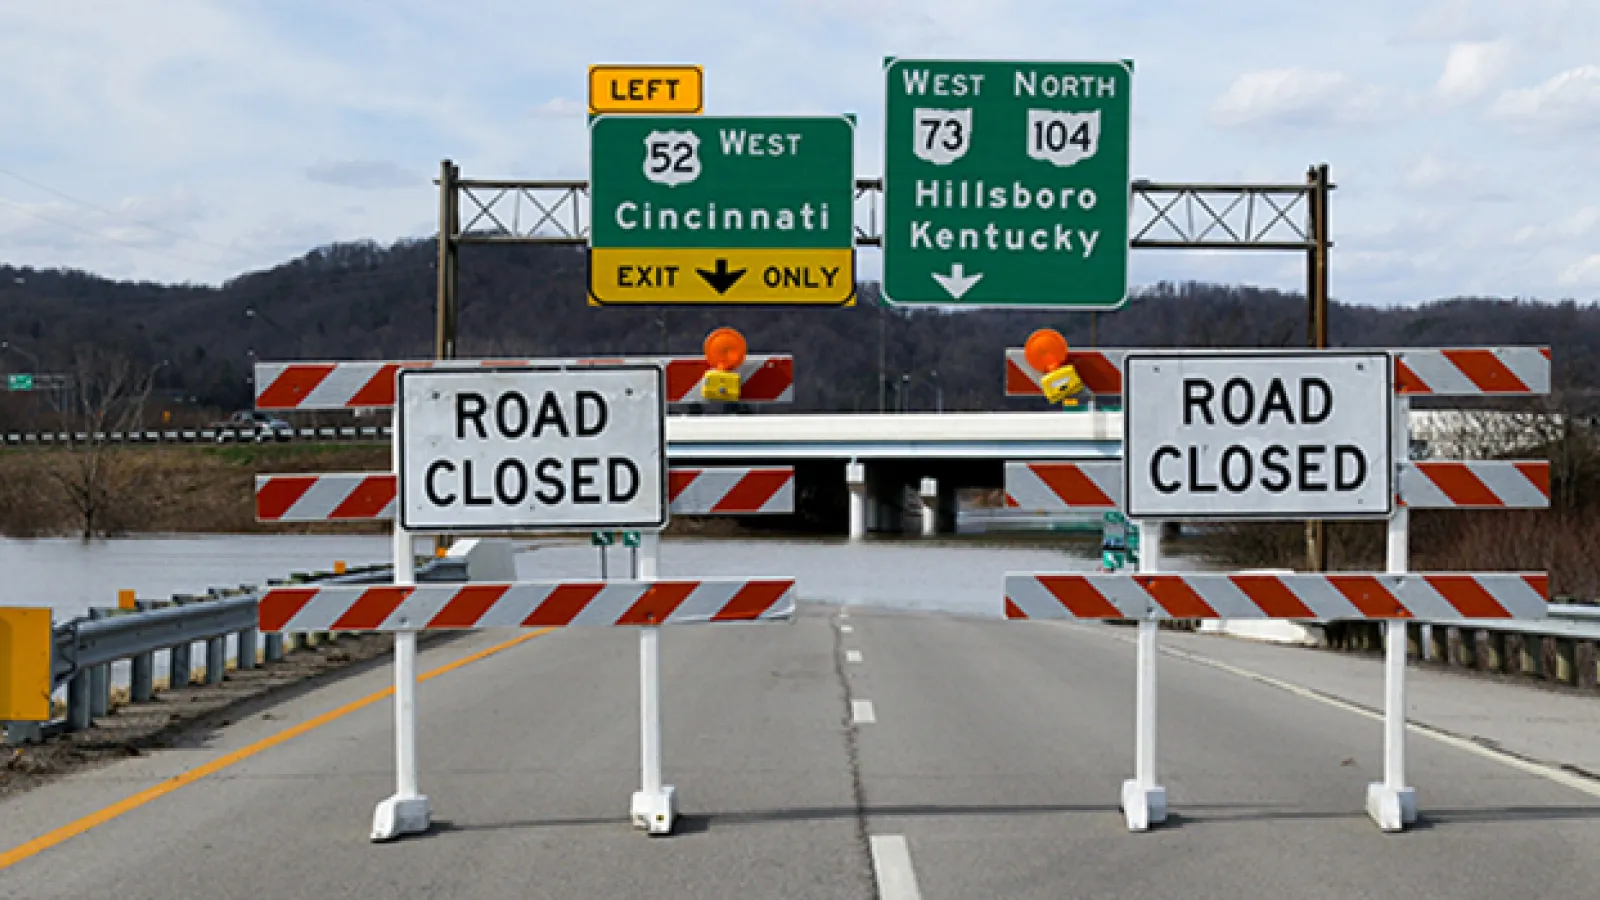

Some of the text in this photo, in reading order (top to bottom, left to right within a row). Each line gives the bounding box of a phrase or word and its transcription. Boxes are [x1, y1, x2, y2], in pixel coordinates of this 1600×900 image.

[611, 79, 680, 100] LEFT
[903, 69, 985, 95] WEST
[1015, 71, 1115, 97] NORTH
[720, 129, 801, 155] WEST
[920, 120, 963, 150] 73
[1034, 121, 1090, 152] 104
[651, 142, 693, 173] 52
[916, 180, 1097, 209] Hillsboro
[615, 202, 829, 230] Cincinnati
[911, 221, 1099, 259] Kentucky
[617, 266, 839, 287] EXIT ONLY
[455, 391, 608, 438] ROAD
[1183, 377, 1332, 425] ROAD
[425, 458, 641, 507] CLOSED
[1150, 445, 1367, 494] CLOSED
